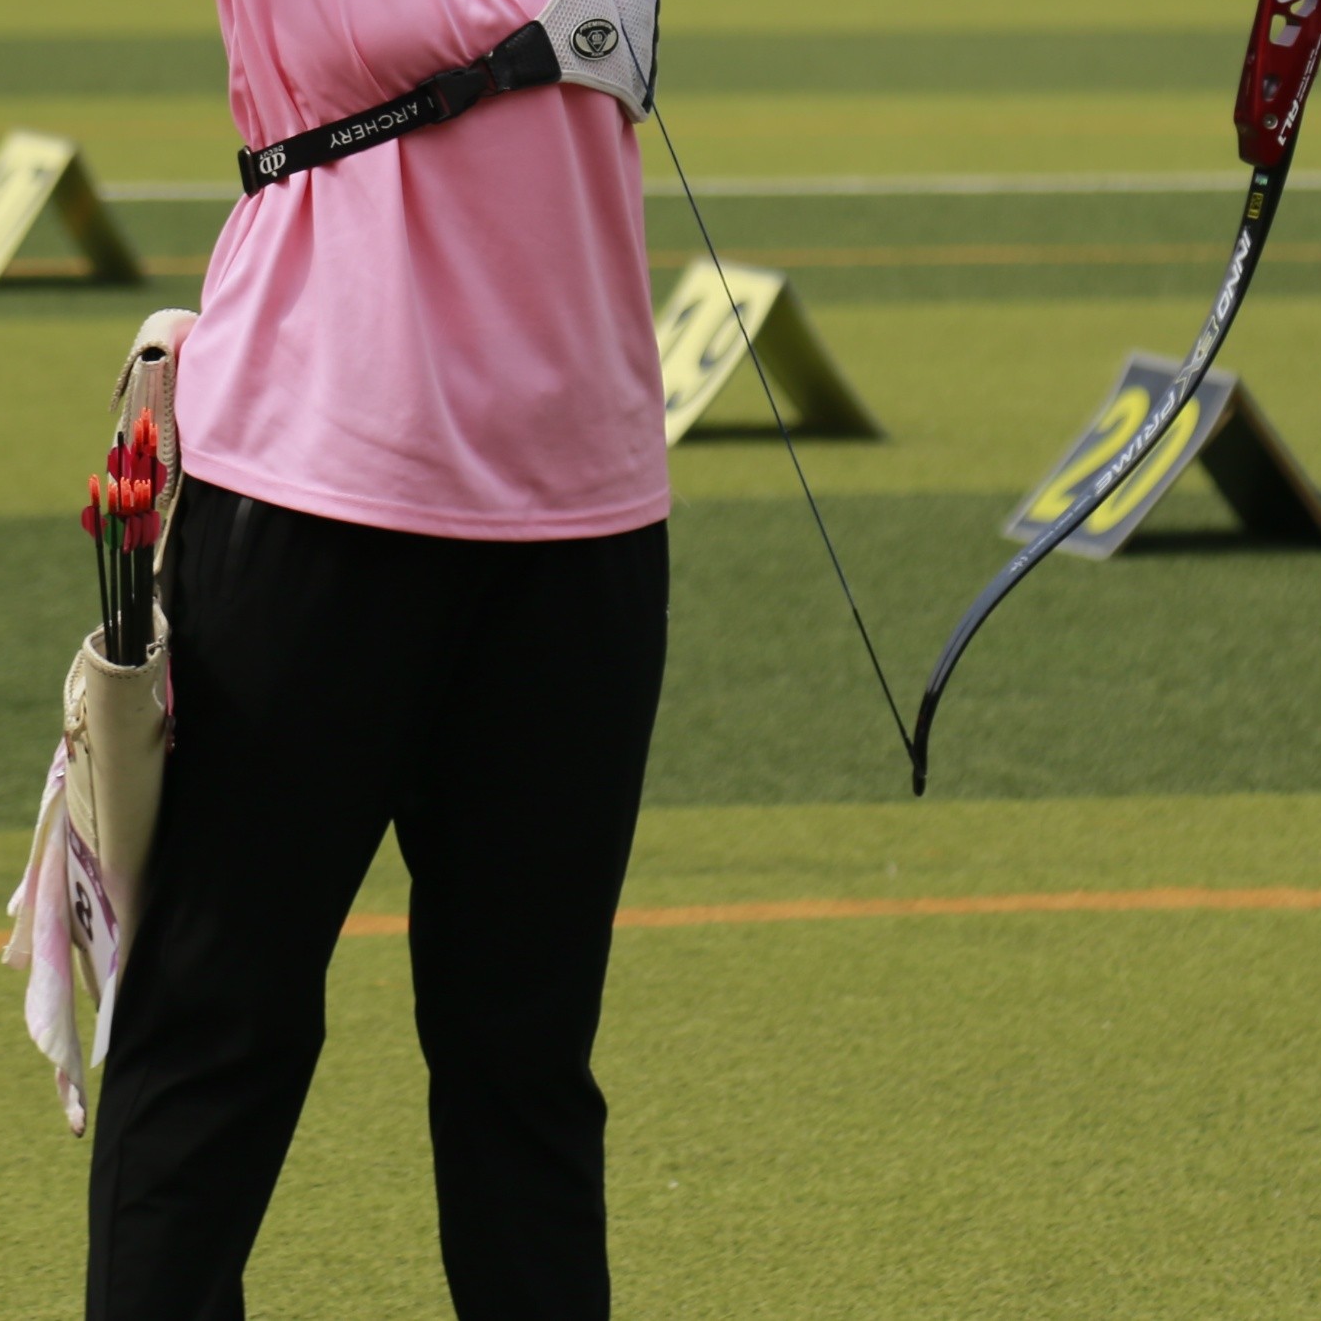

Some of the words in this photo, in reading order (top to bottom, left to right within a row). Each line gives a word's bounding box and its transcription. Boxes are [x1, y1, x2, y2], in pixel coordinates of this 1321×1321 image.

[330, 101, 419, 149] ARCHERY
[1217, 229, 1252, 321] INNO
[1027, 385, 1201, 535] 20
[1094, 390, 1176, 495] PRIME
